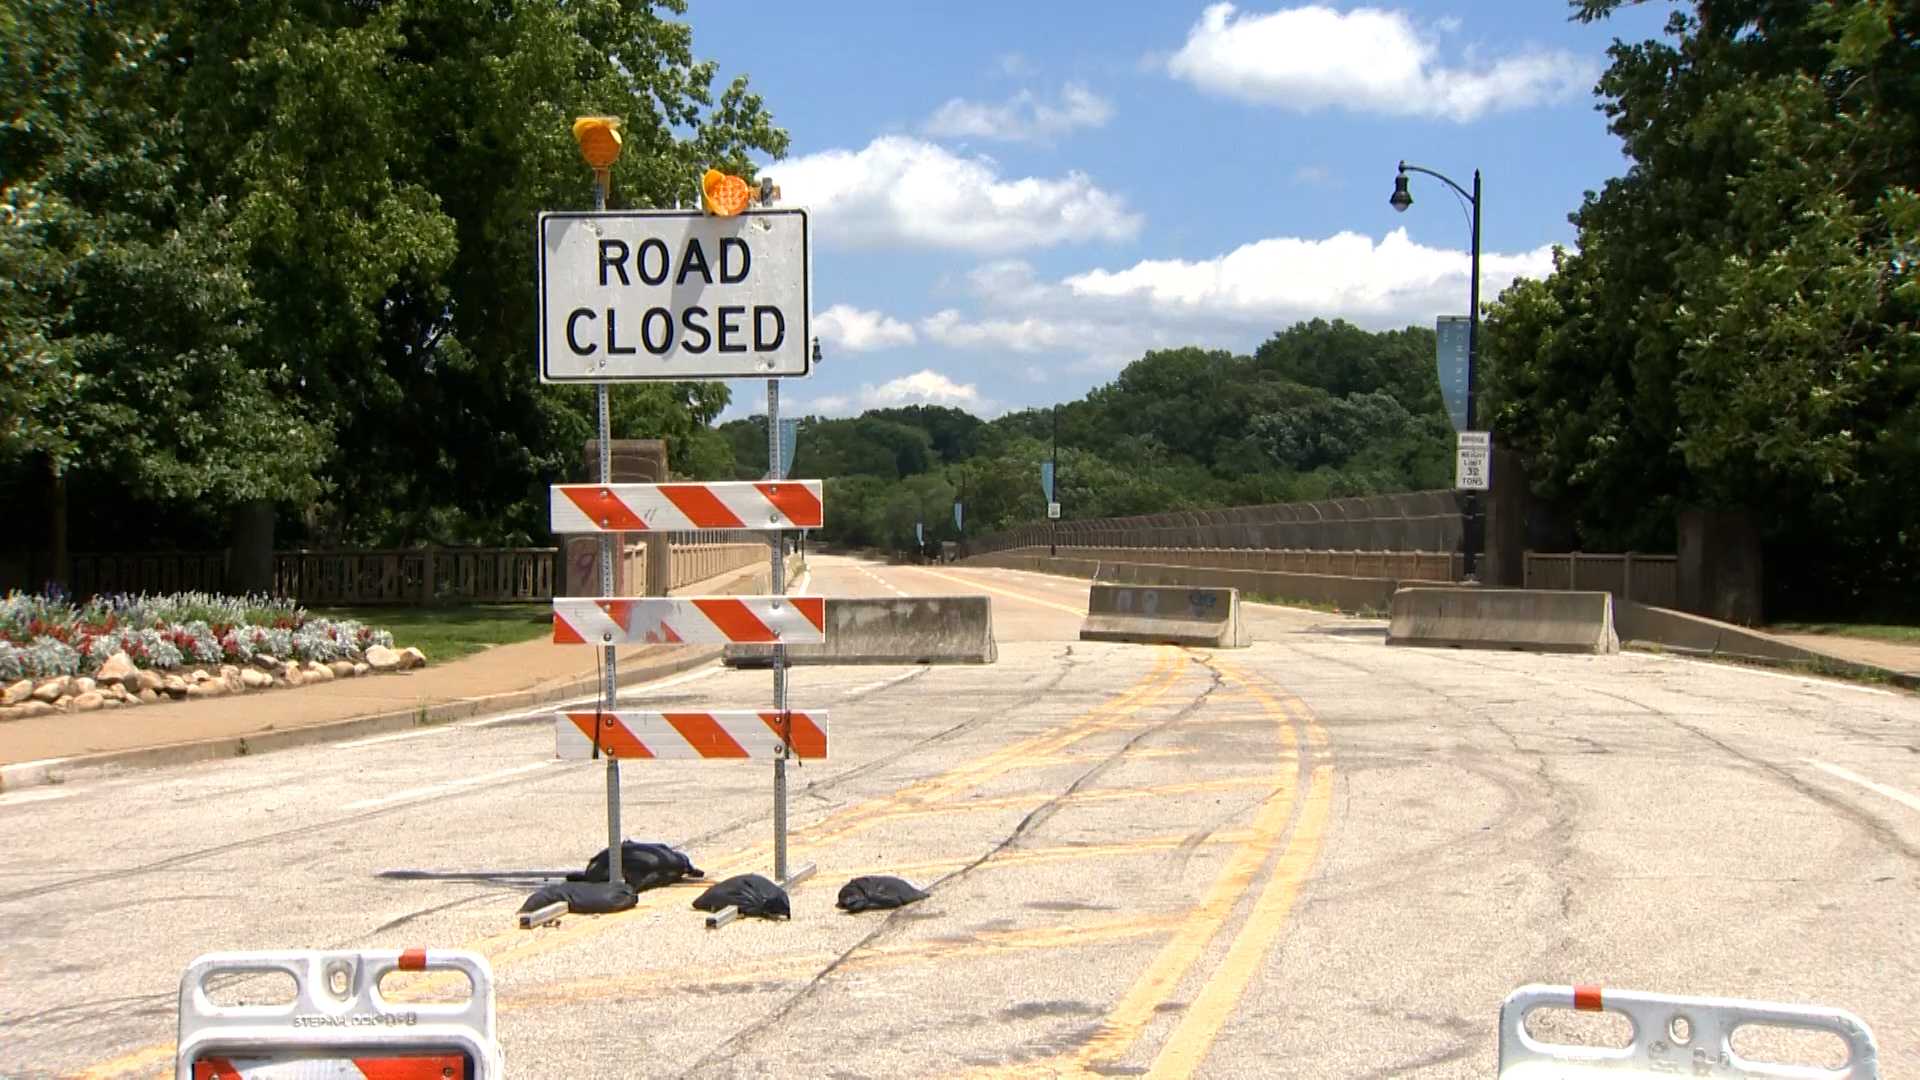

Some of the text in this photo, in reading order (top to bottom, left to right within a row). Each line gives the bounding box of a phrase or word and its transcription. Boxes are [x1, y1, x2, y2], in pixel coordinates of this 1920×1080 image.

[598, 238, 750, 285] ROAD
[566, 306, 785, 355] CLOSED
[1462, 476, 1483, 486] TONS
[1466, 467, 1480, 475] 32
